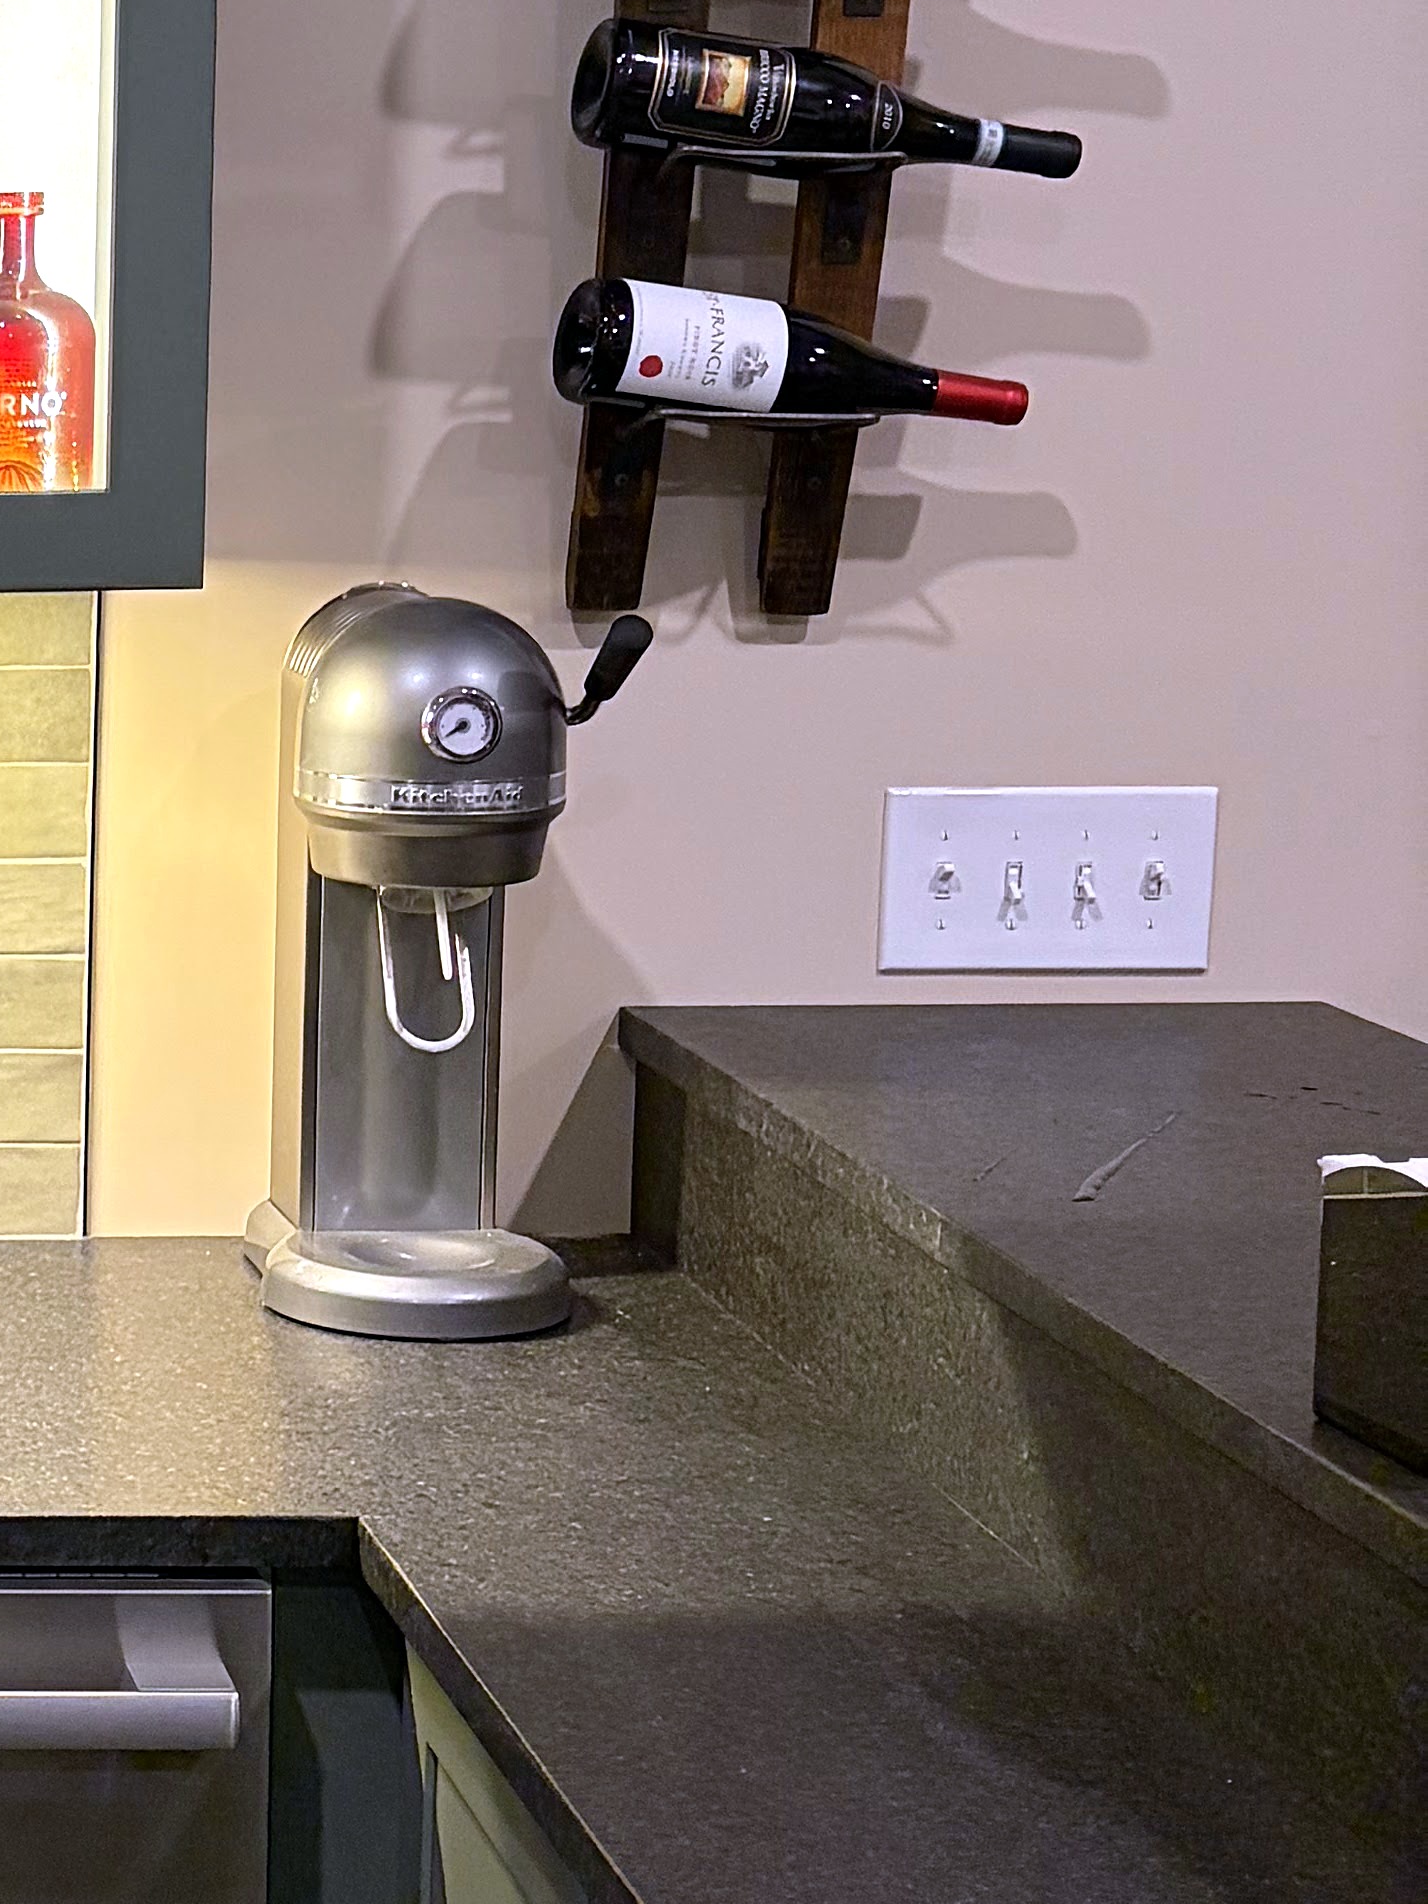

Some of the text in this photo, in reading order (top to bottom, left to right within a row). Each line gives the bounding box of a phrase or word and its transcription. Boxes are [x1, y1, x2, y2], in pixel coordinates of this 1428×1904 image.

[882, 102, 893, 130] 2010
[701, 307, 725, 387] FRANCIS
[390, 783, 524, 805] KitchenAid
